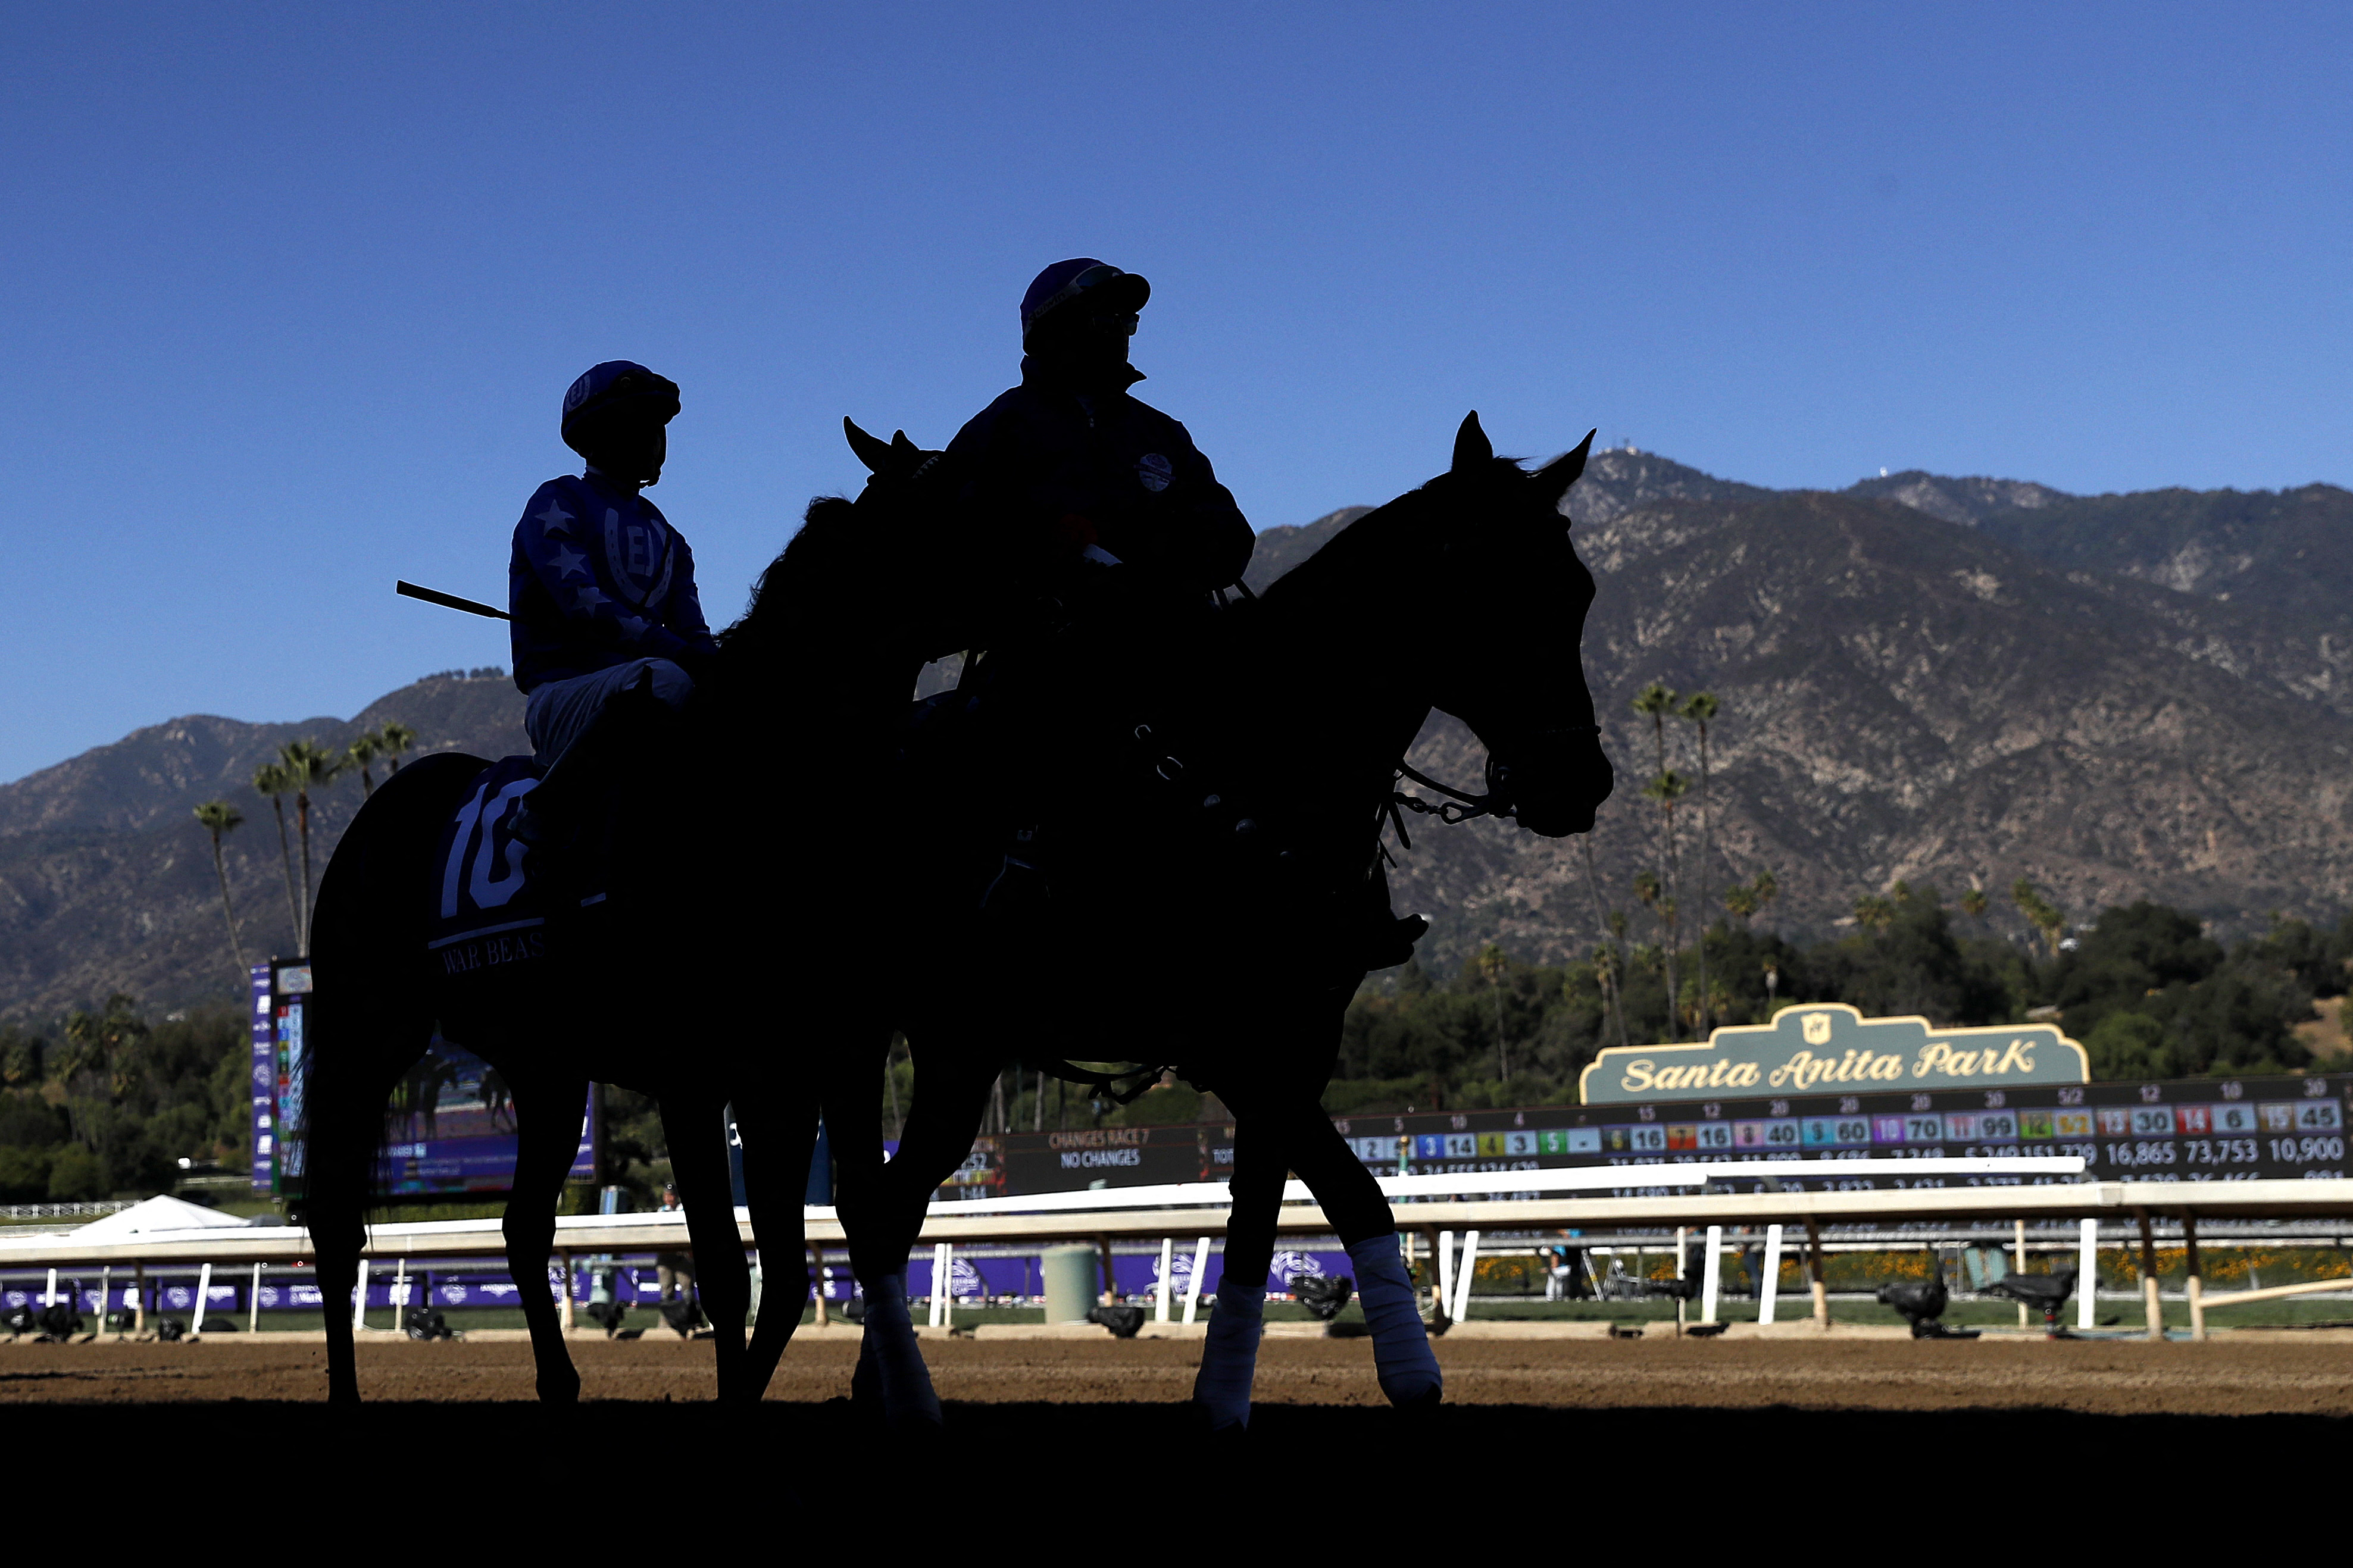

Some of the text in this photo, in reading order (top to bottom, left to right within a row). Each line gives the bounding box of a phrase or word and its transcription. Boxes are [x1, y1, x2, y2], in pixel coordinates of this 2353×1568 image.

[442, 944, 481, 975] WAR
[1621, 1058, 1761, 1093] Santa
[1768, 1049, 1904, 1090] Anita
[1048, 1131, 1105, 1148] CHANGES
[1447, 1137, 1473, 1154] 14
[1636, 1132, 1663, 1147] 16
[1703, 1129, 1726, 1144] 16
[1768, 1125, 1795, 1141] 40
[1838, 1121, 1865, 1139] 60
[1908, 1119, 1937, 1137] 70
[2136, 1111, 2167, 1130] 30
[2226, 1109, 2242, 1128] 6
[2301, 1106, 2335, 1126] 45
[1061, 1148, 1141, 1169] NO CHANGES
[2105, 1141, 2177, 1169] 16,865
[2183, 1138, 2260, 1167] 73,753
[2268, 1135, 2345, 1166] 10,900
